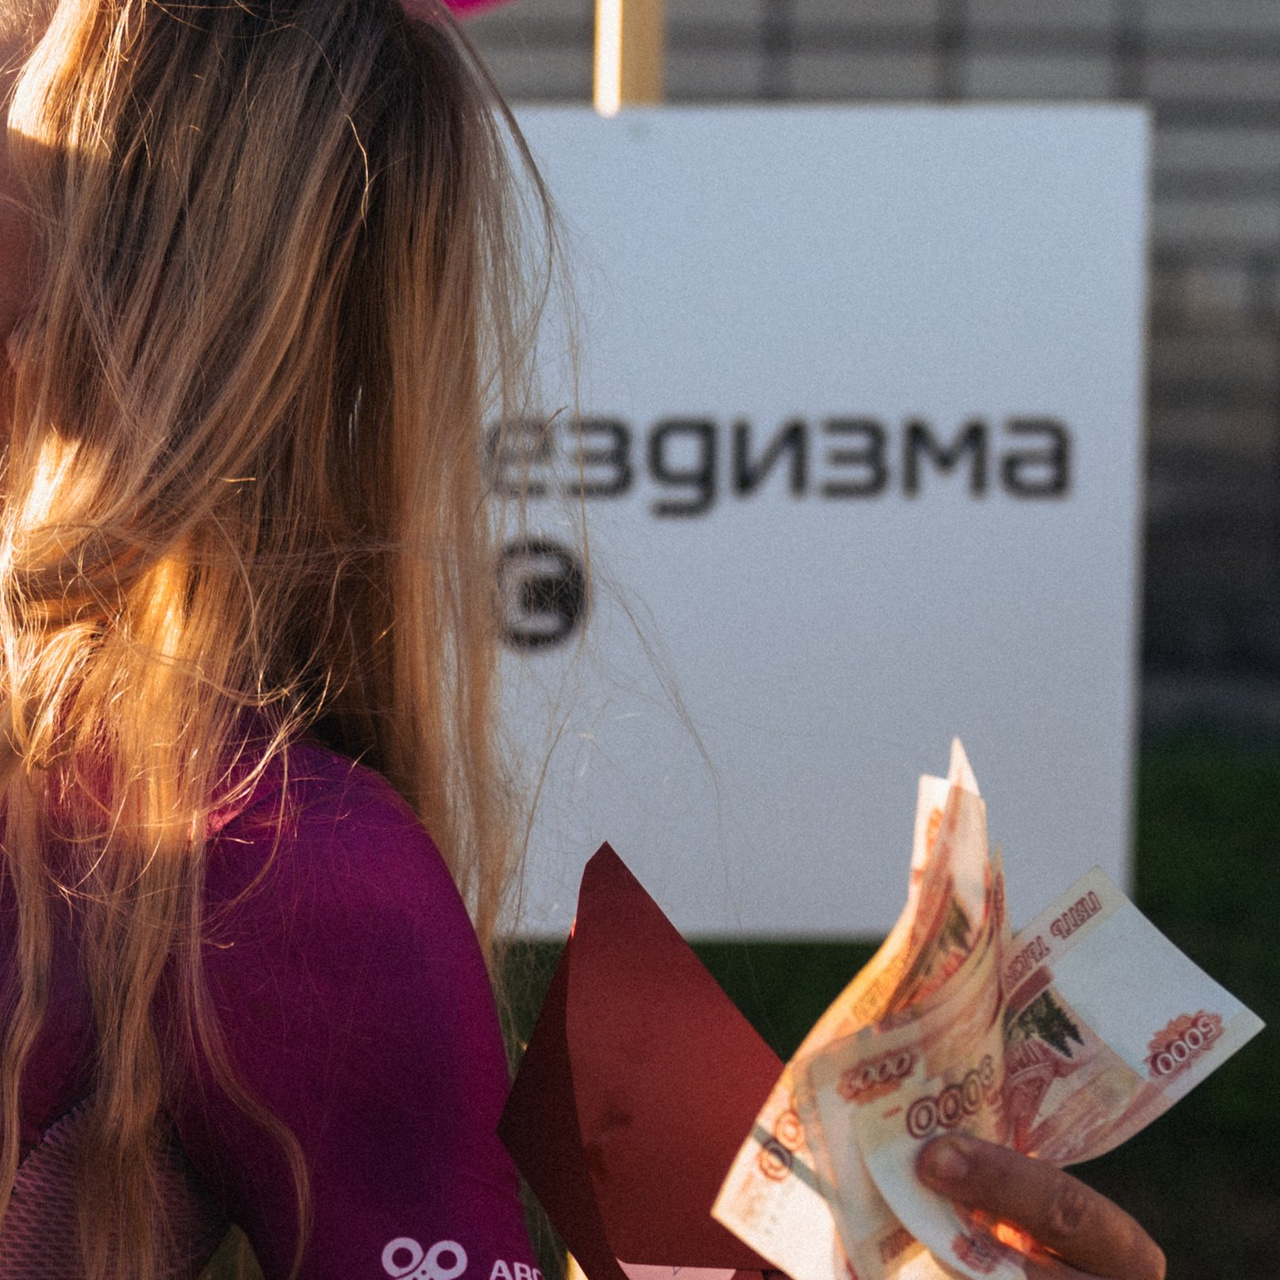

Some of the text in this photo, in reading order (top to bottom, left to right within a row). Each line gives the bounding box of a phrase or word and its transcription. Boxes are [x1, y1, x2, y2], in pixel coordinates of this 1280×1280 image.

[485, 416, 1070, 519] ездизма
[1050, 890, 1103, 940] ПЯТЬ
[1157, 1016, 1217, 1074] 5000
